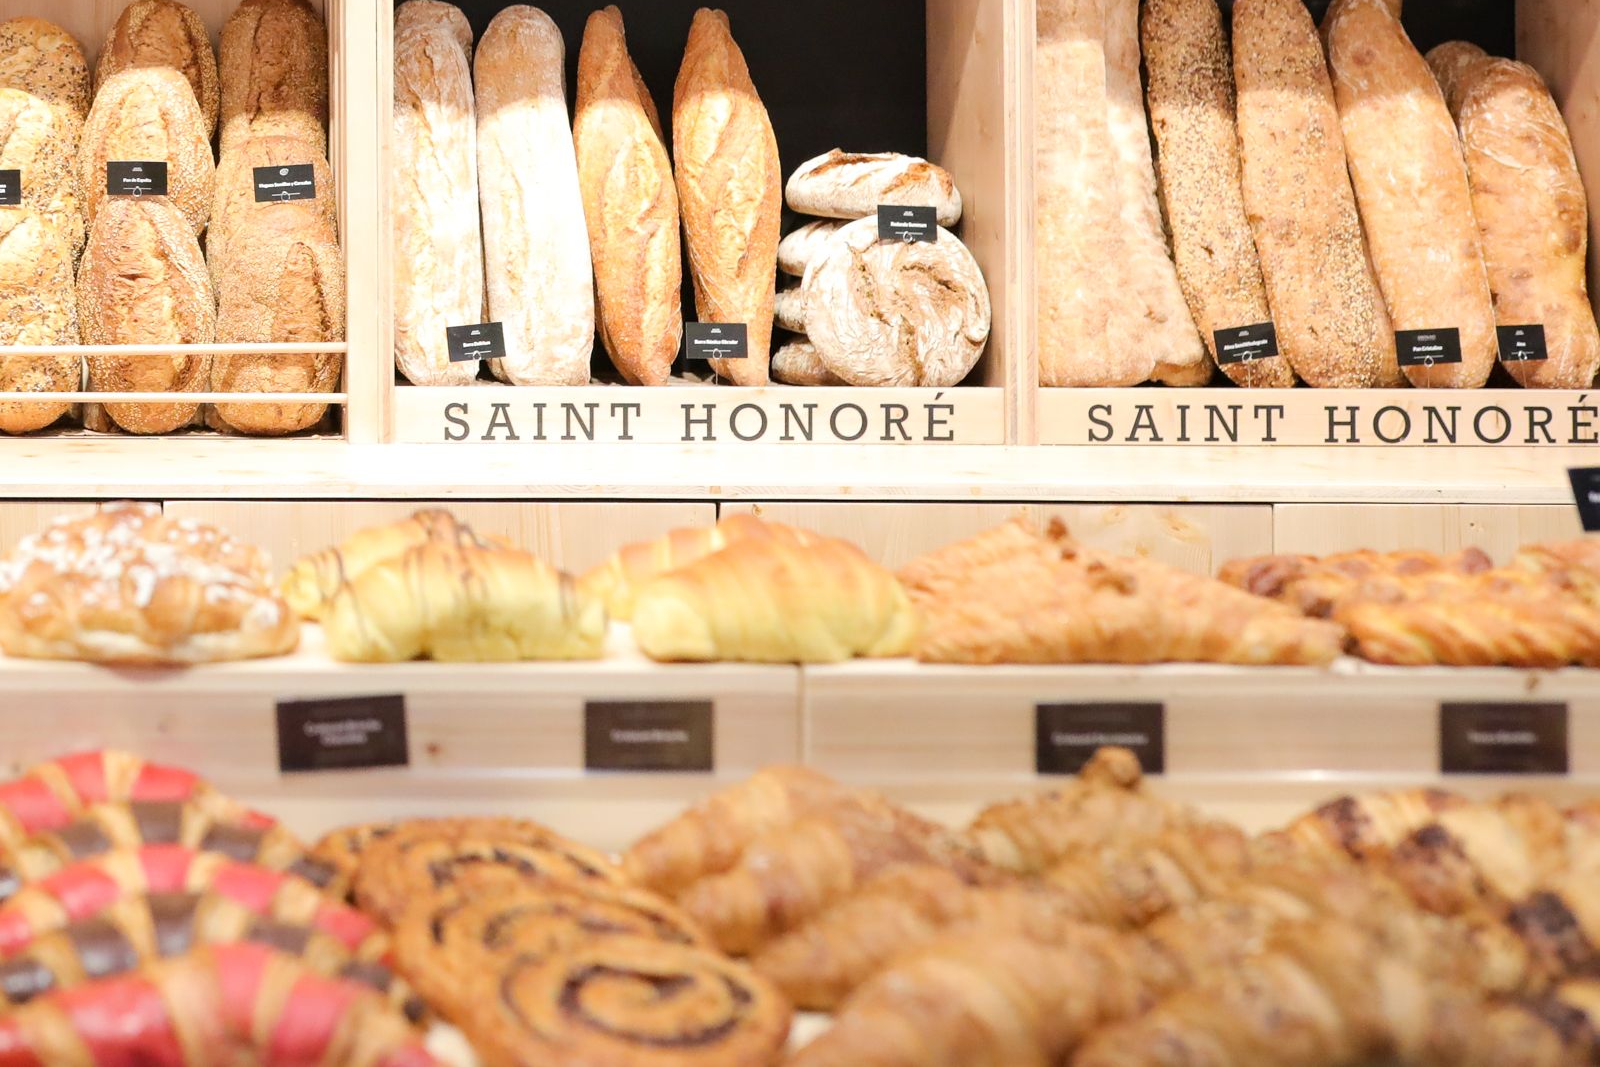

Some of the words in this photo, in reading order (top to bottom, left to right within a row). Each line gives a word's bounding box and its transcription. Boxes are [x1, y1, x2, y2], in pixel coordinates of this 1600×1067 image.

[445, 402, 641, 441] SAINT
[681, 391, 955, 441] HONORÉ
[1088, 404, 1285, 442] SAINT
[1324, 393, 1600, 444] HONORÉ
